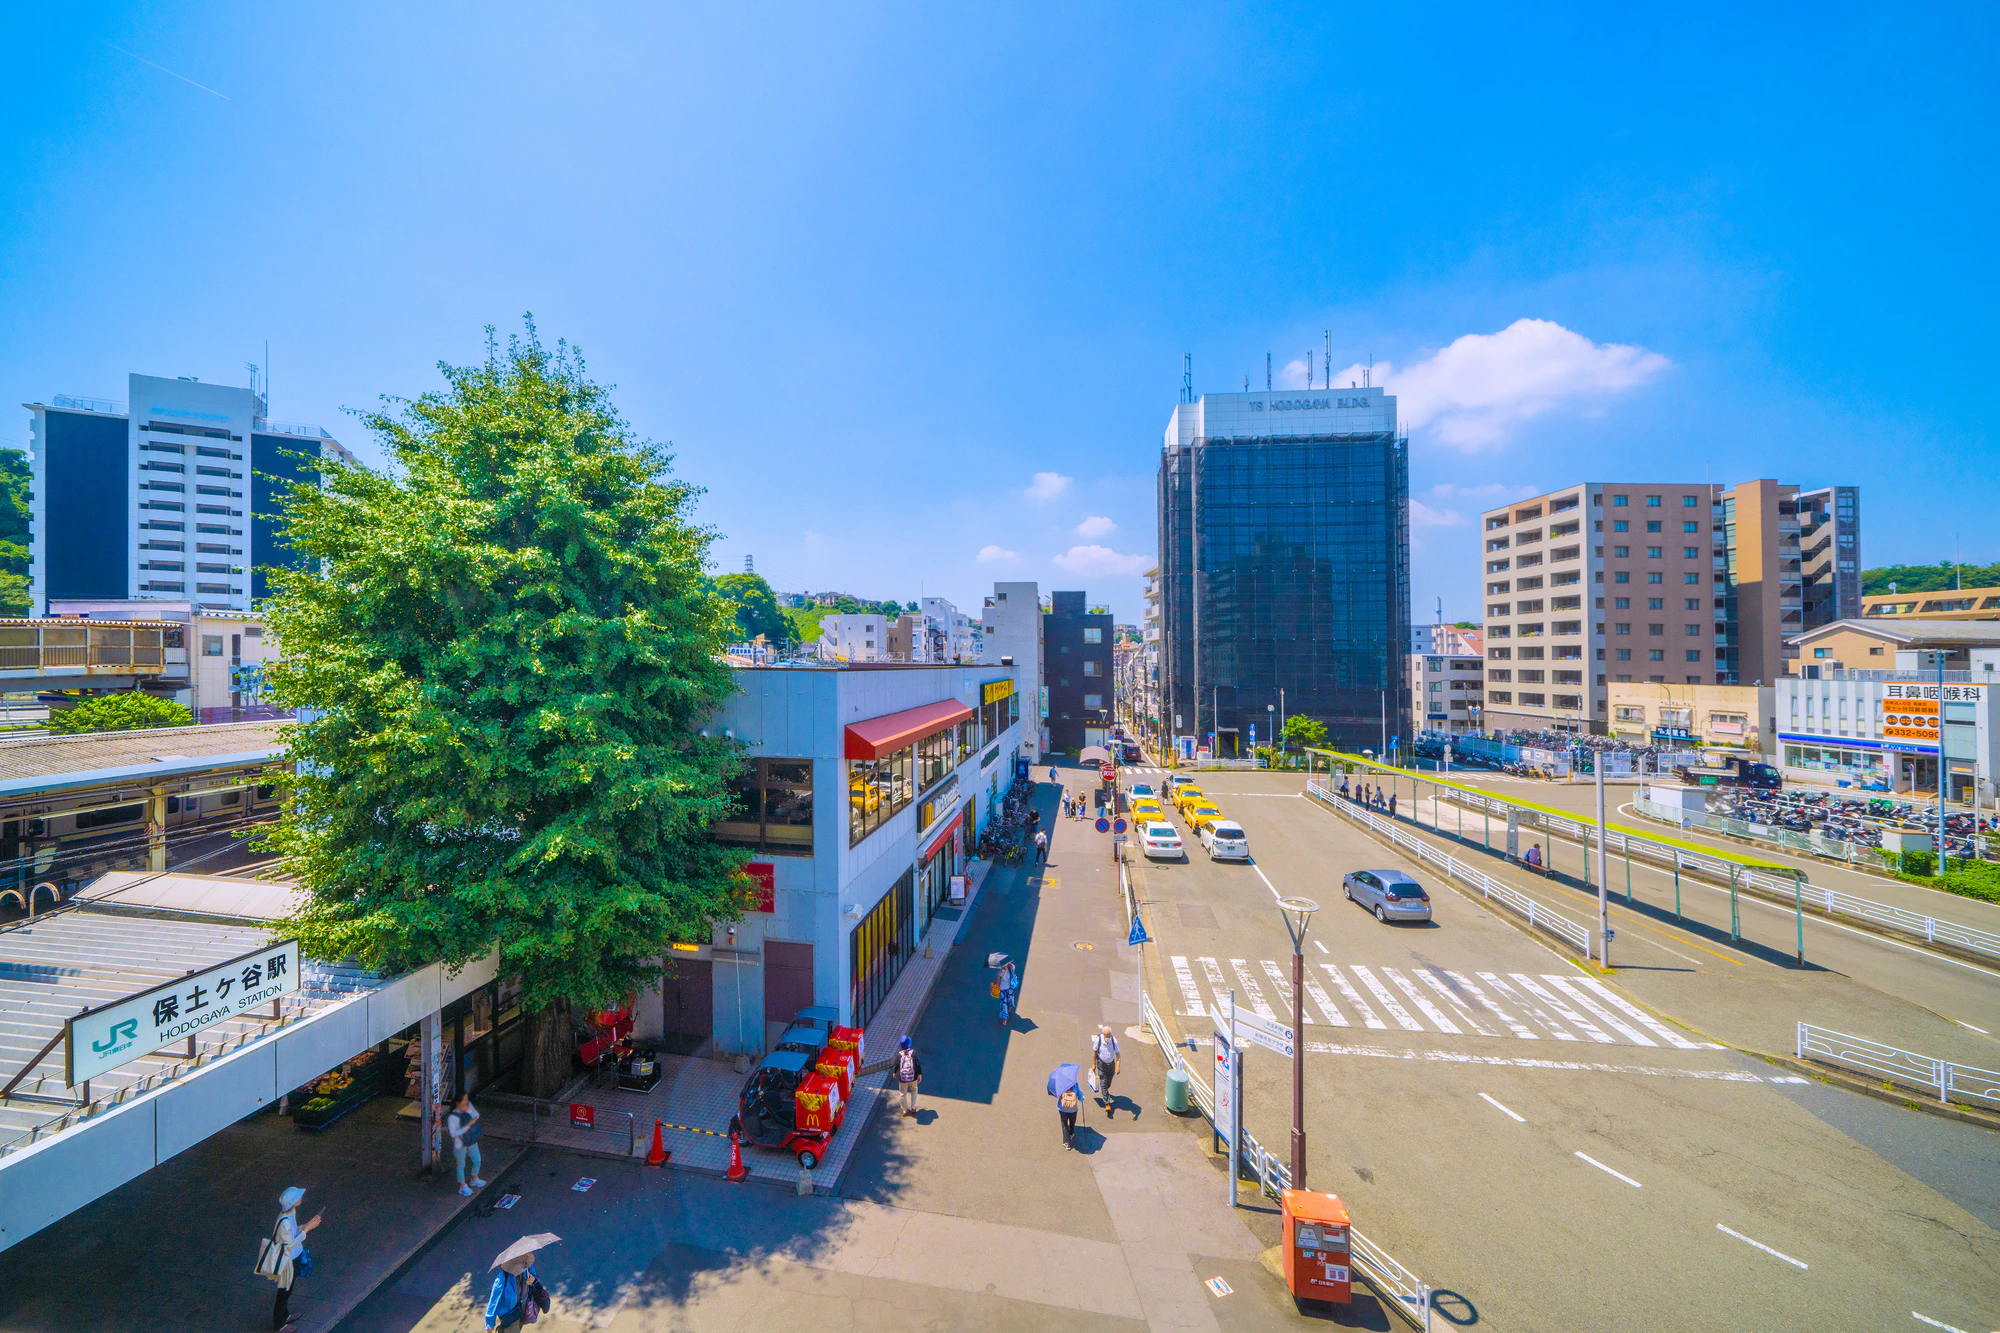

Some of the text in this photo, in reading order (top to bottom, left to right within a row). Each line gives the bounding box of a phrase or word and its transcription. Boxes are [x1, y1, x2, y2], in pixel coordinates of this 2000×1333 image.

[1269, 399, 1331, 411] HODOGAYA
[1888, 686, 1981, 701] 耳鼻咽喉科
[152, 953, 287, 1028] 保土ケ谷駅
[160, 983, 282, 1043] HODOGAYA STATION
